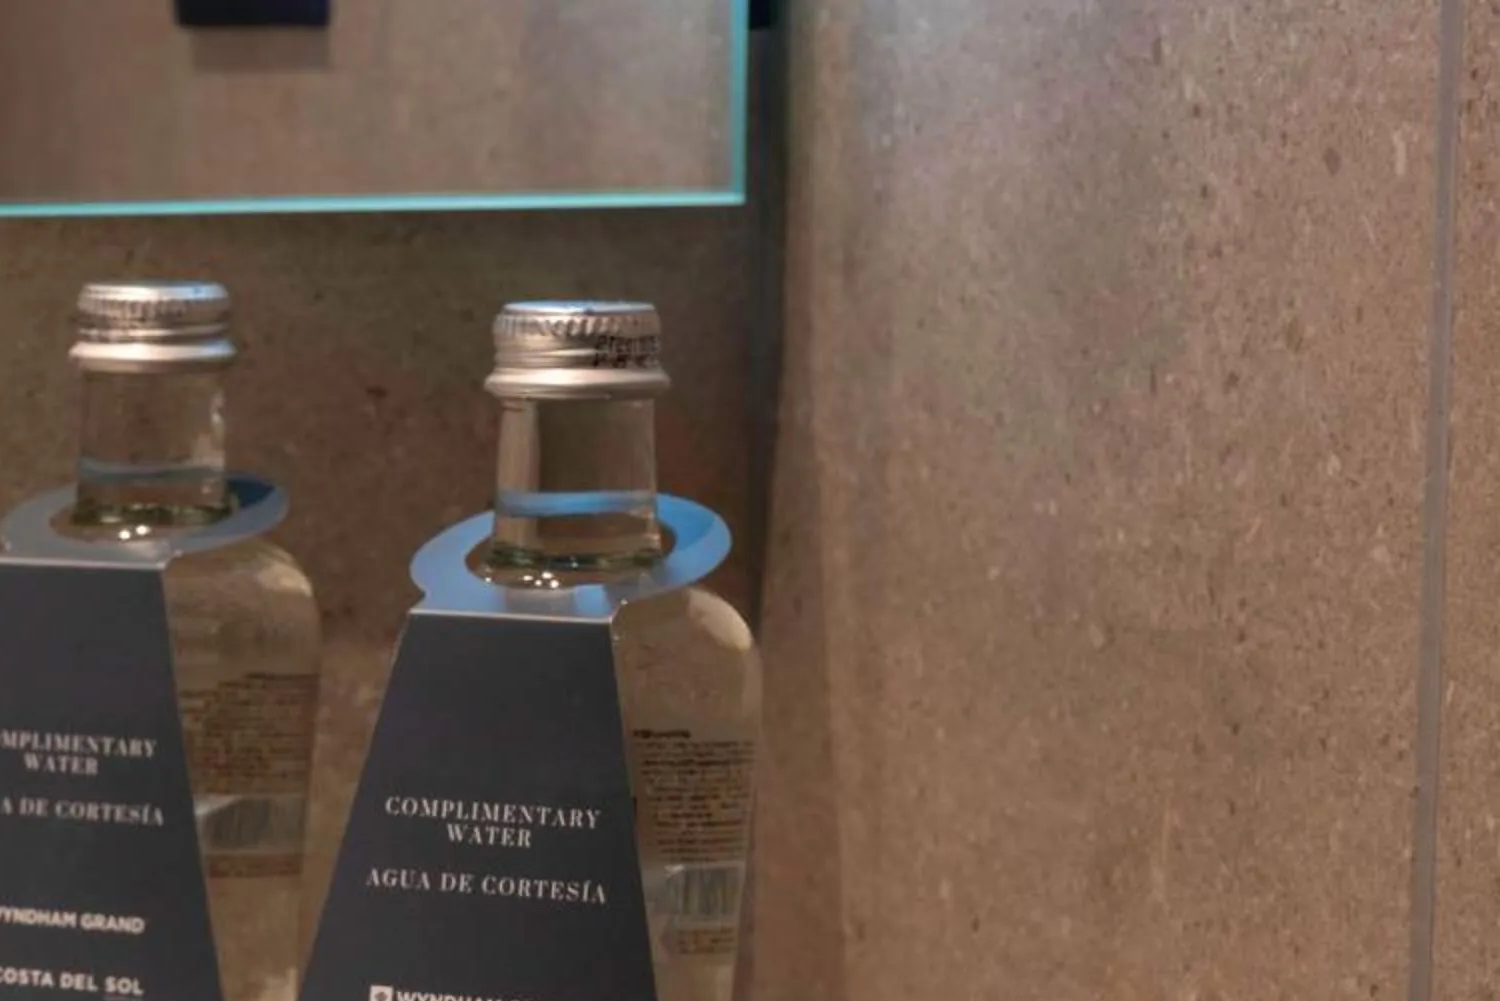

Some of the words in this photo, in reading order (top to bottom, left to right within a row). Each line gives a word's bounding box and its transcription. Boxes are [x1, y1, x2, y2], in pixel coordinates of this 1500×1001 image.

[23, 753, 100, 776] WATER
[19, 797, 50, 818] DE
[55, 797, 165, 826] CORTESÍA
[384, 796, 602, 829] COMPLIMENTARY
[446, 825, 533, 848] WATER
[366, 868, 431, 891] AGUA
[440, 873, 473, 893] DE
[481, 874, 607, 903] CORTESÍA
[81, 913, 145, 934] GRAND
[59, 972, 98, 992] DEL
[104, 976, 145, 996] SOL
